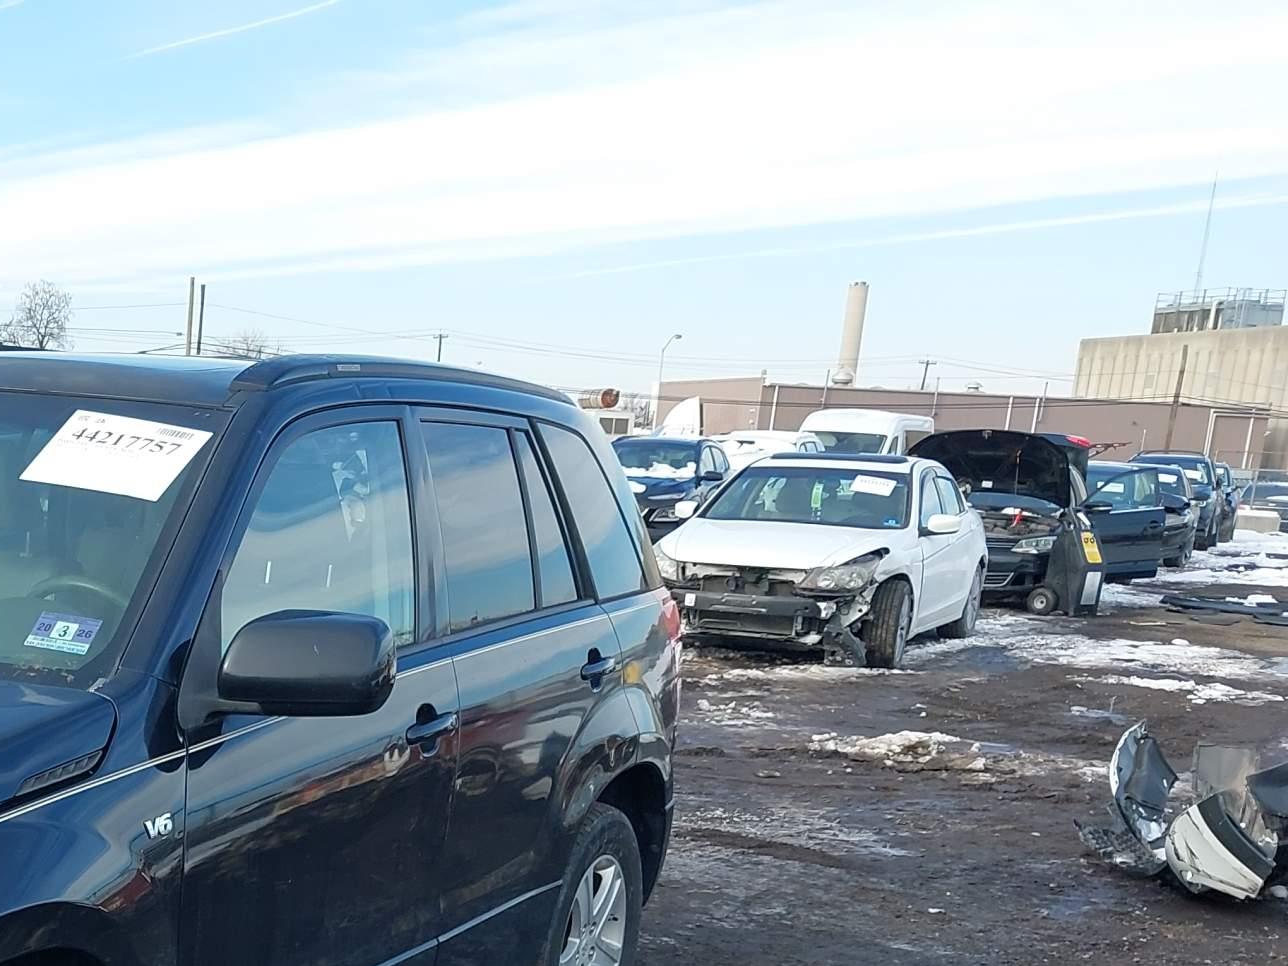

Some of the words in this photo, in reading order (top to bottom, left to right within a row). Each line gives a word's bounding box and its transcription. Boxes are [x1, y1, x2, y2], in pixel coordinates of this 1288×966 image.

[72, 427, 183, 456] 44217757
[36, 622, 53, 632] 20
[58, 625, 70, 638] 3
[77, 629, 93, 639] 26
[144, 812, 173, 839] V6
